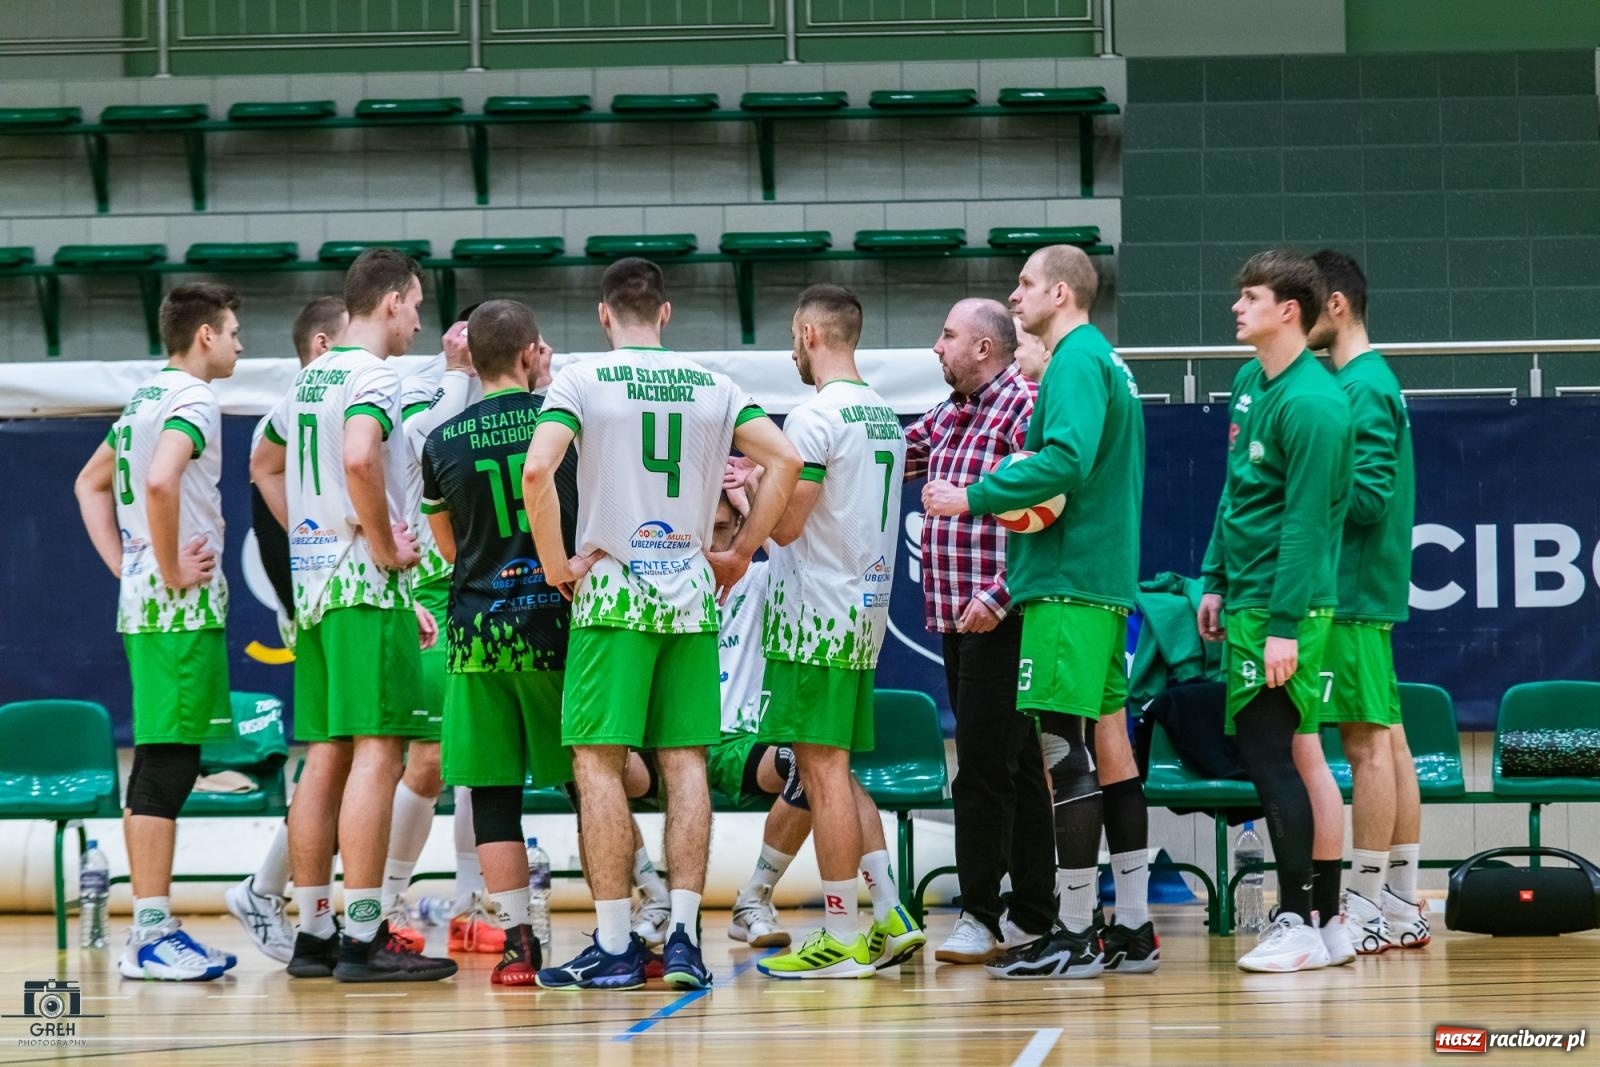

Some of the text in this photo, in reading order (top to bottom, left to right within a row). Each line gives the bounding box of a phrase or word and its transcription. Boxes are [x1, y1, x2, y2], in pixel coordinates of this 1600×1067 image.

[596, 366, 716, 387] KLUB SIATKARSKI
[627, 382, 695, 402] RACIBÓRZ
[839, 404, 866, 424] KLUB
[442, 418, 477, 441] KLUB
[641, 411, 682, 498] 4
[874, 450, 895, 533] 7
[631, 539, 692, 549] UBEZPIECZENIA
[667, 533, 692, 541] MULTI
[1318, 671, 1335, 703] 7
